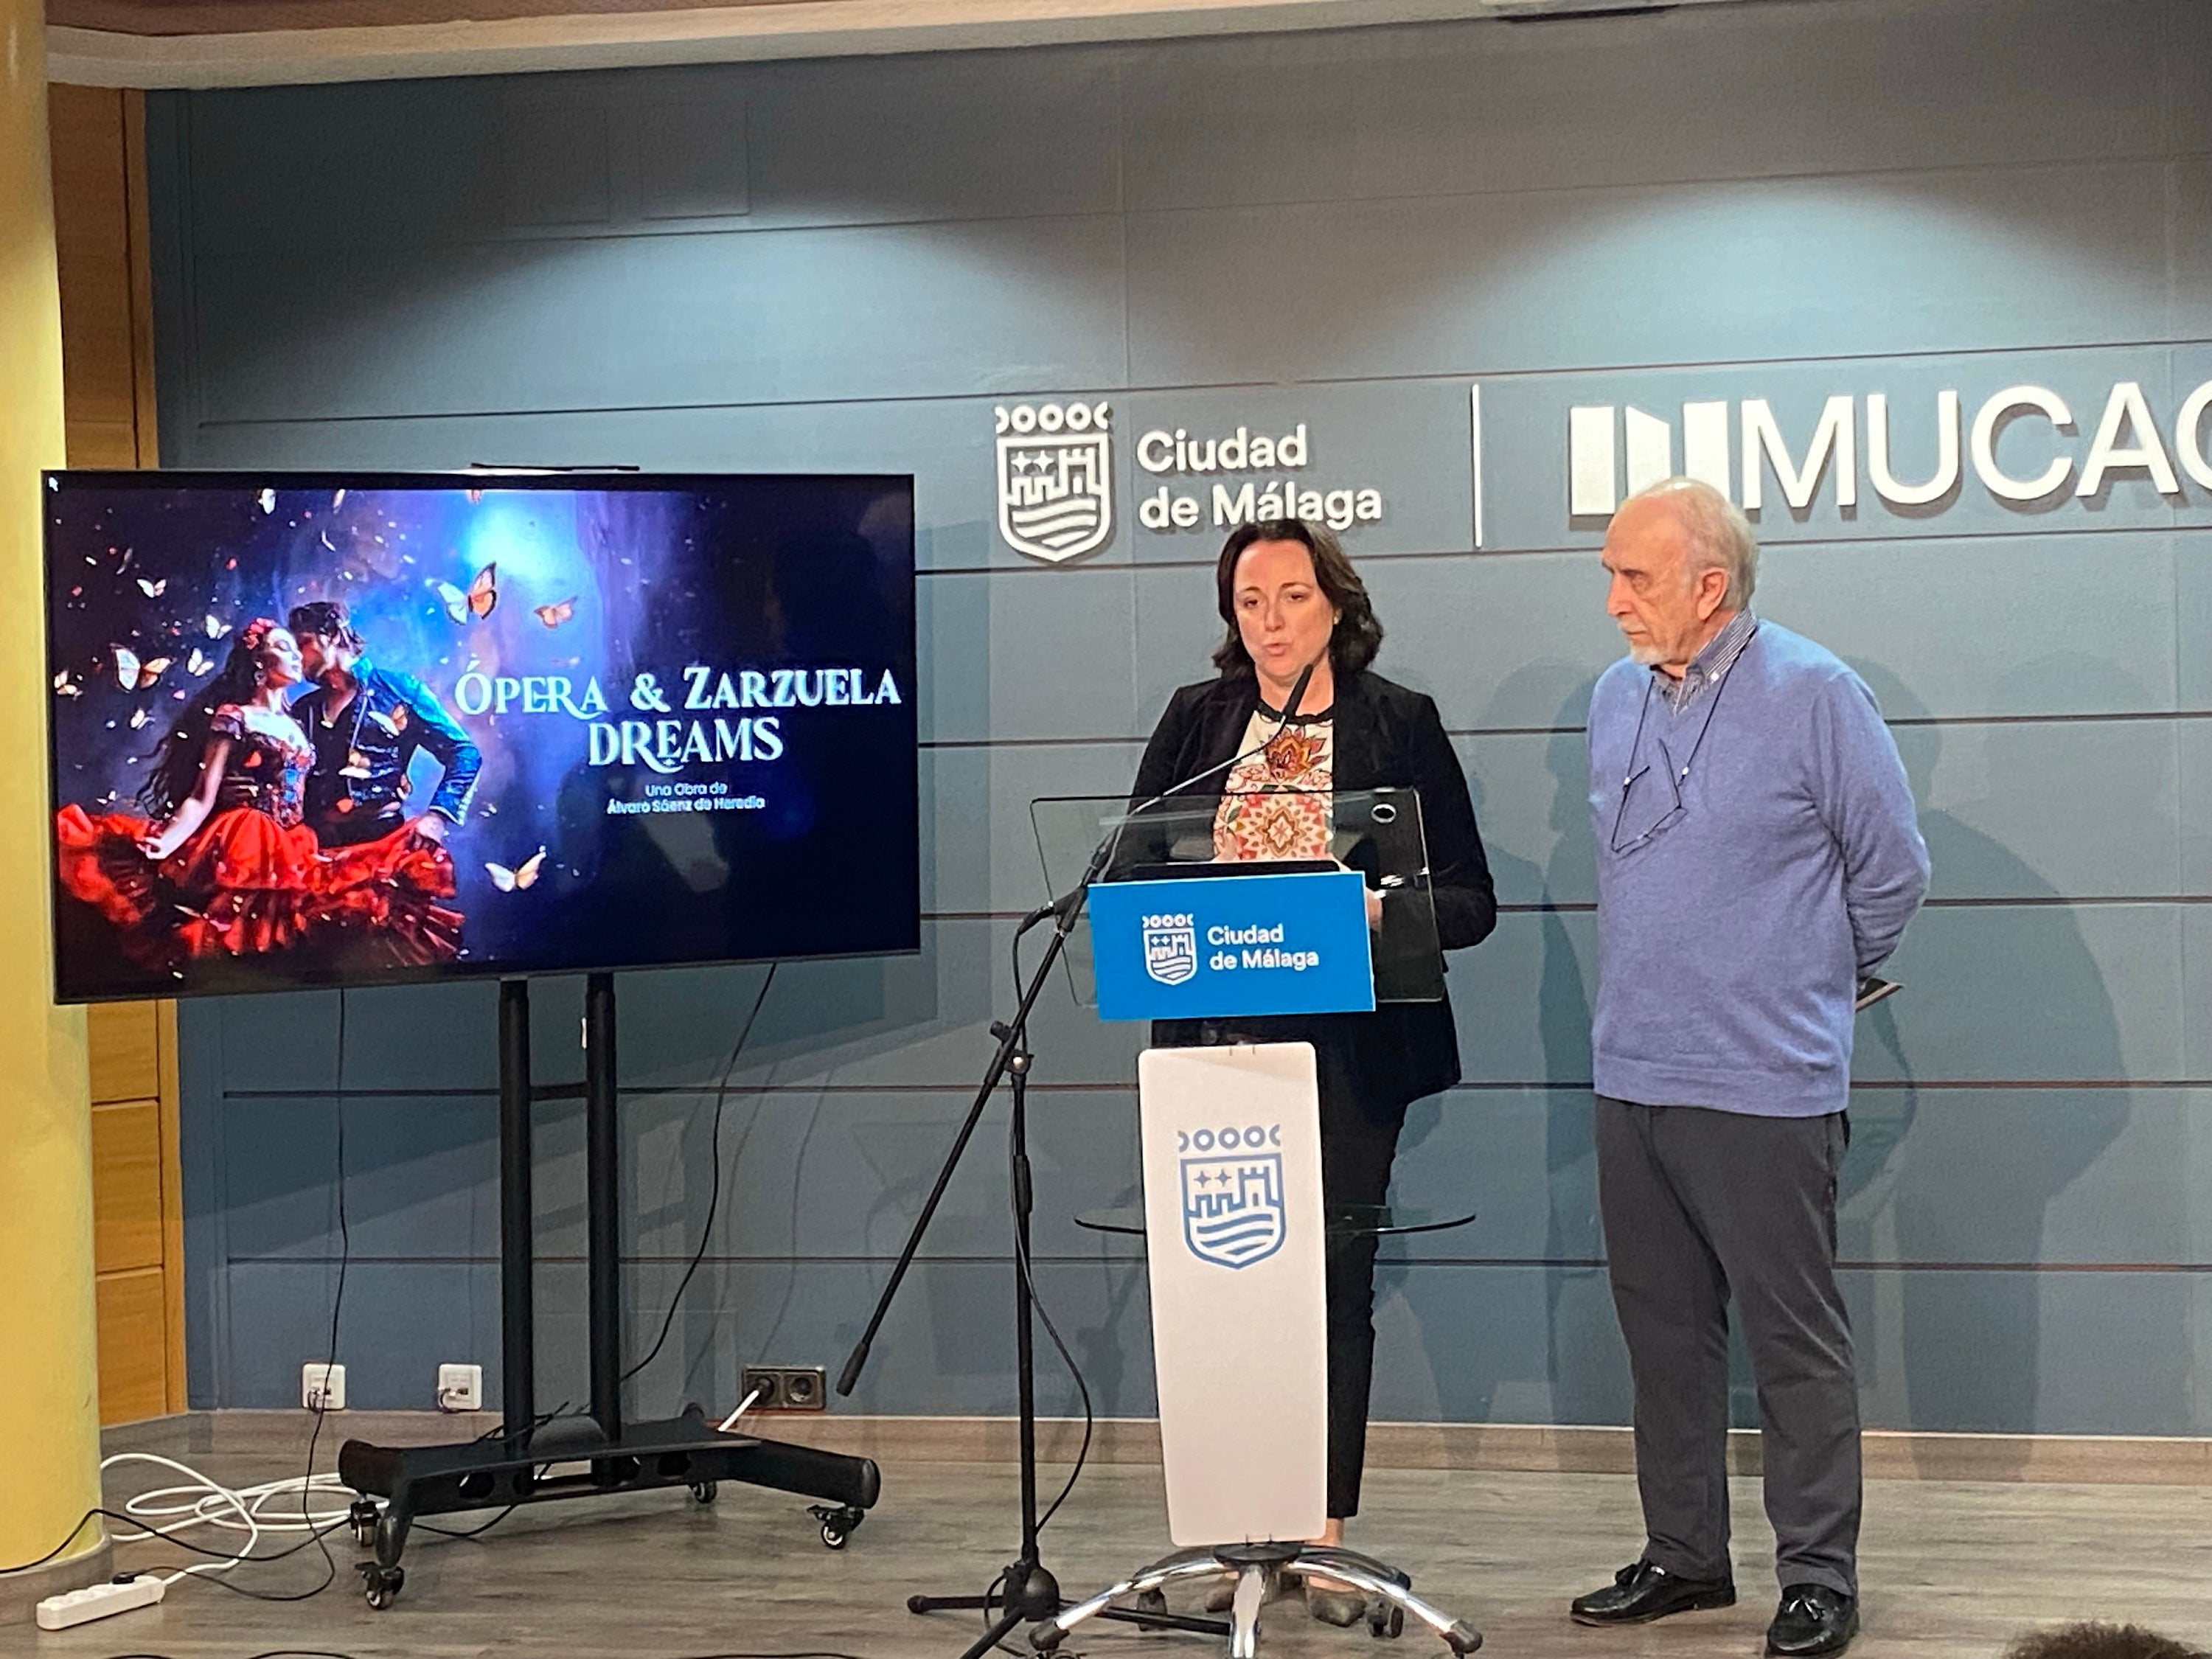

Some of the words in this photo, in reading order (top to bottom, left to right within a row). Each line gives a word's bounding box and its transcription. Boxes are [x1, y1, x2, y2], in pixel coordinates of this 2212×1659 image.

[1136, 423, 1307, 473] Ciudad
[1139, 486, 1200, 529] de
[1212, 481, 1382, 531] Málaga
[454, 663, 611, 720] ÓPERA
[630, 673, 672, 712] &
[683, 666, 902, 711] ZARZUELA
[588, 717, 784, 774] DREAMS
[606, 798, 651, 814] Álvaro
[652, 798, 693, 813] Sáenz
[694, 797, 712, 811] de
[713, 795, 766, 810] Heredia
[644, 783, 672, 798] Una
[674, 782, 708, 796] Obra
[709, 781, 728, 795] de
[1206, 922, 1284, 946] Ciudad
[1208, 950, 1238, 971] de
[1242, 947, 1320, 972] Málaga
